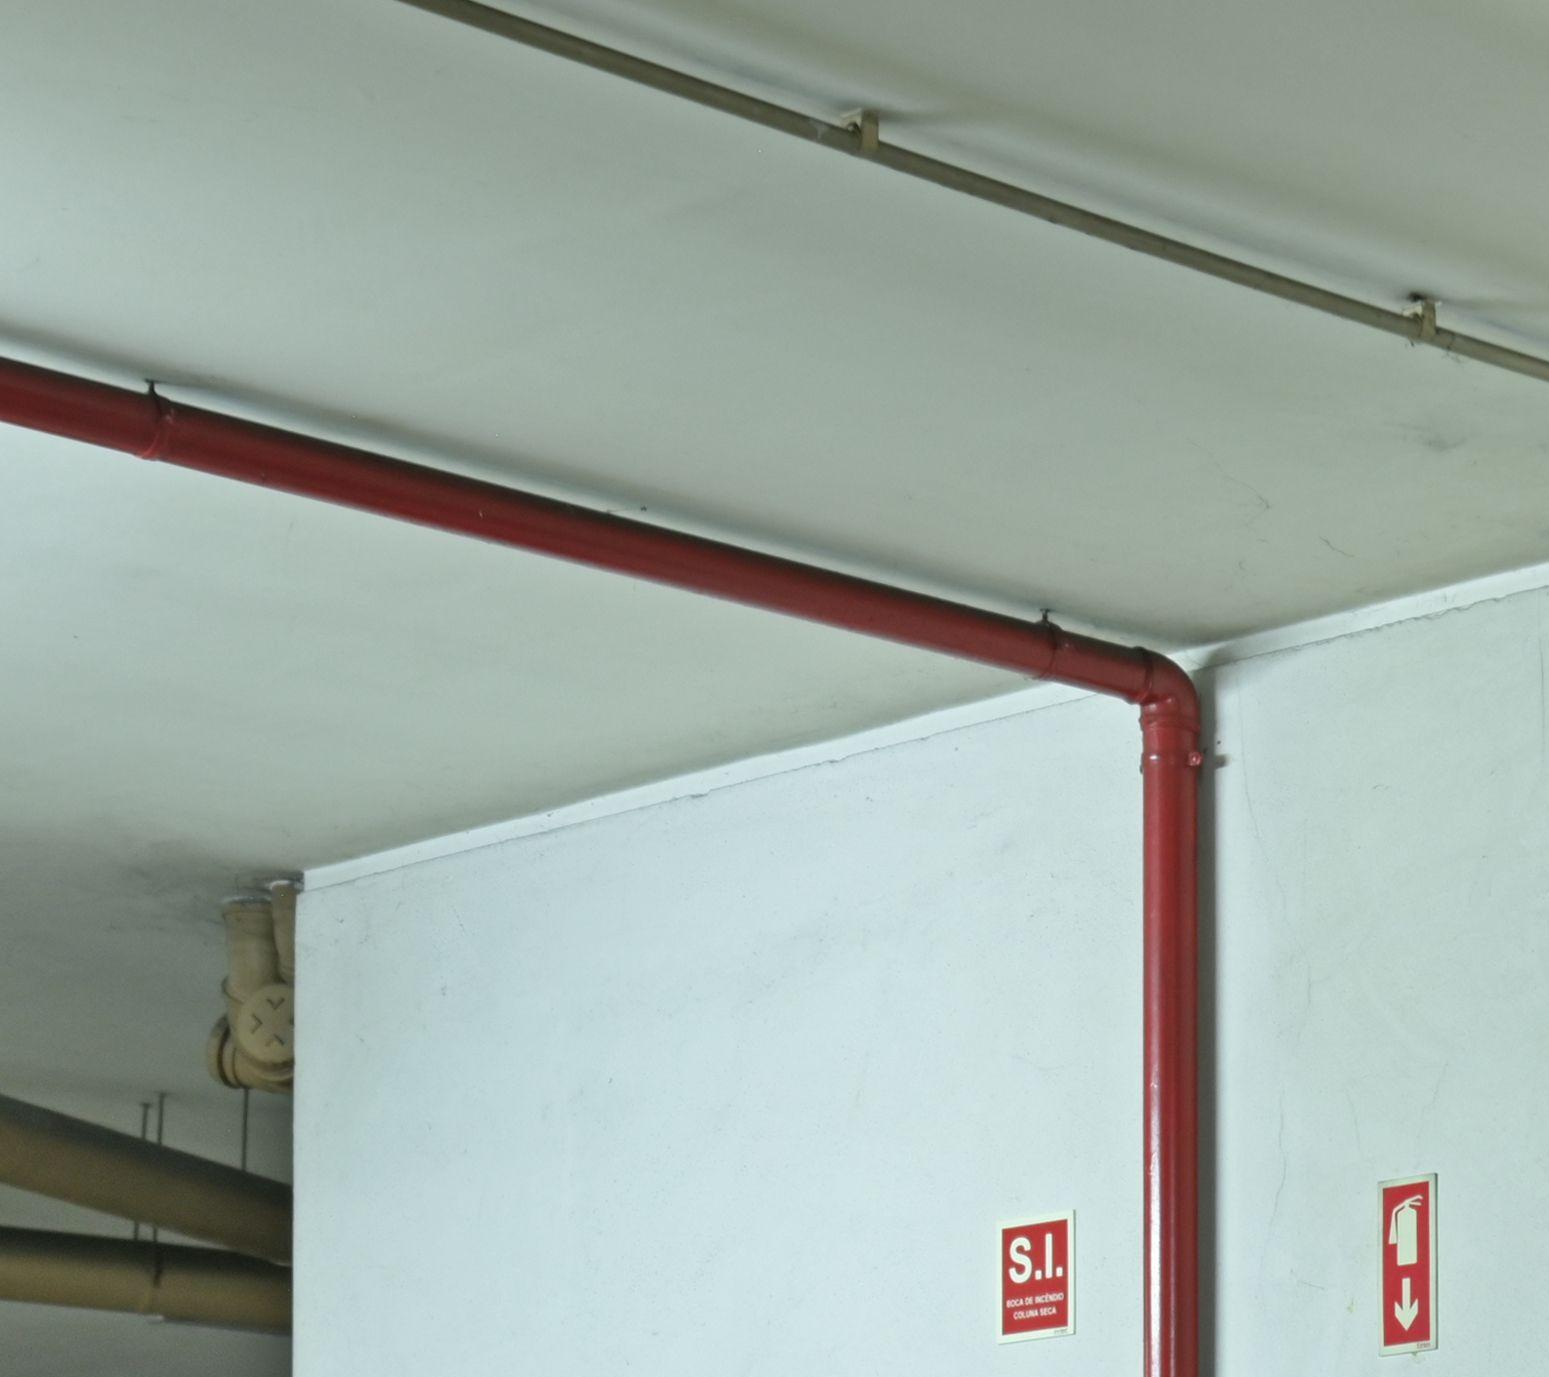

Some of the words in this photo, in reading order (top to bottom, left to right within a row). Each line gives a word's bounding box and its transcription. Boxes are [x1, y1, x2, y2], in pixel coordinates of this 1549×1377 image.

[1009, 1233, 1063, 1283] S.I.
[1006, 1299, 1024, 1308] BOCA
[1025, 1296, 1033, 1305] DE
[1013, 1309, 1039, 1320] COLUNA
[1040, 1306, 1057, 1316] SECA
